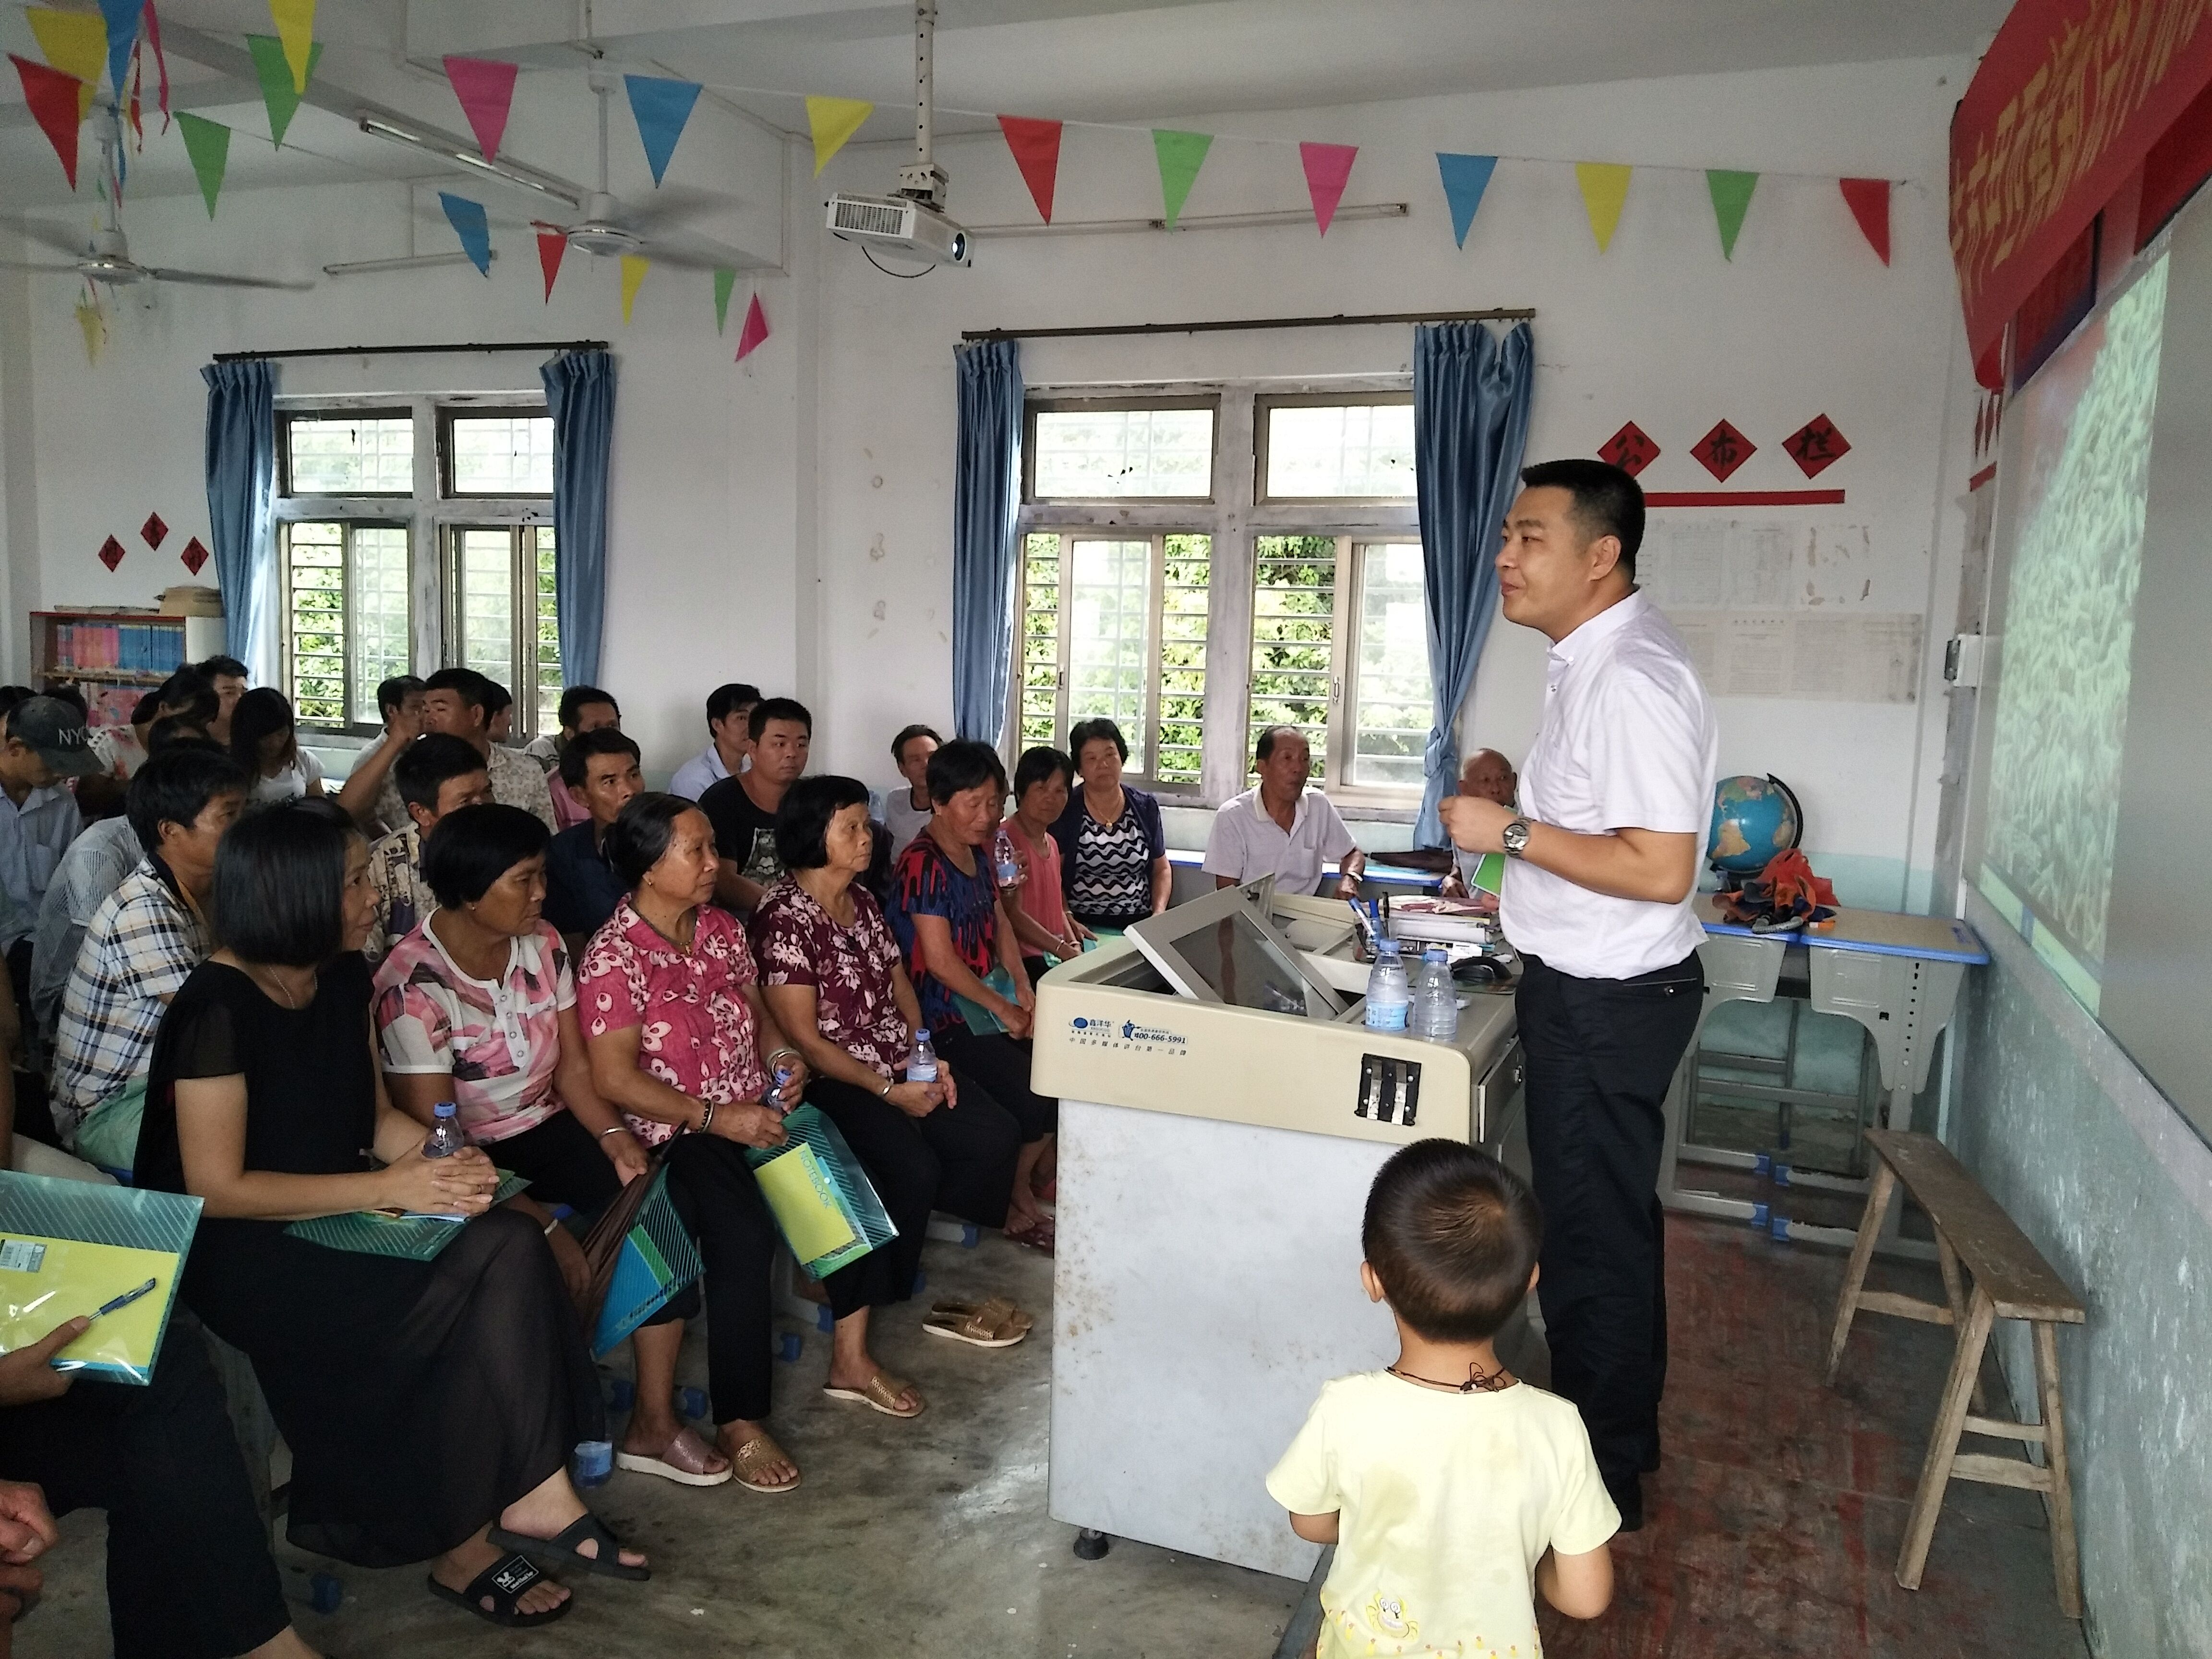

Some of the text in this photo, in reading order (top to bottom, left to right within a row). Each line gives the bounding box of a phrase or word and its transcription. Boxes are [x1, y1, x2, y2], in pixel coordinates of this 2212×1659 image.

[1615, 426, 1837, 470] 公布栏
[1134, 1033, 1185, 1044] 400-666-5991
[799, 1150, 831, 1209] NOTEBOOK
